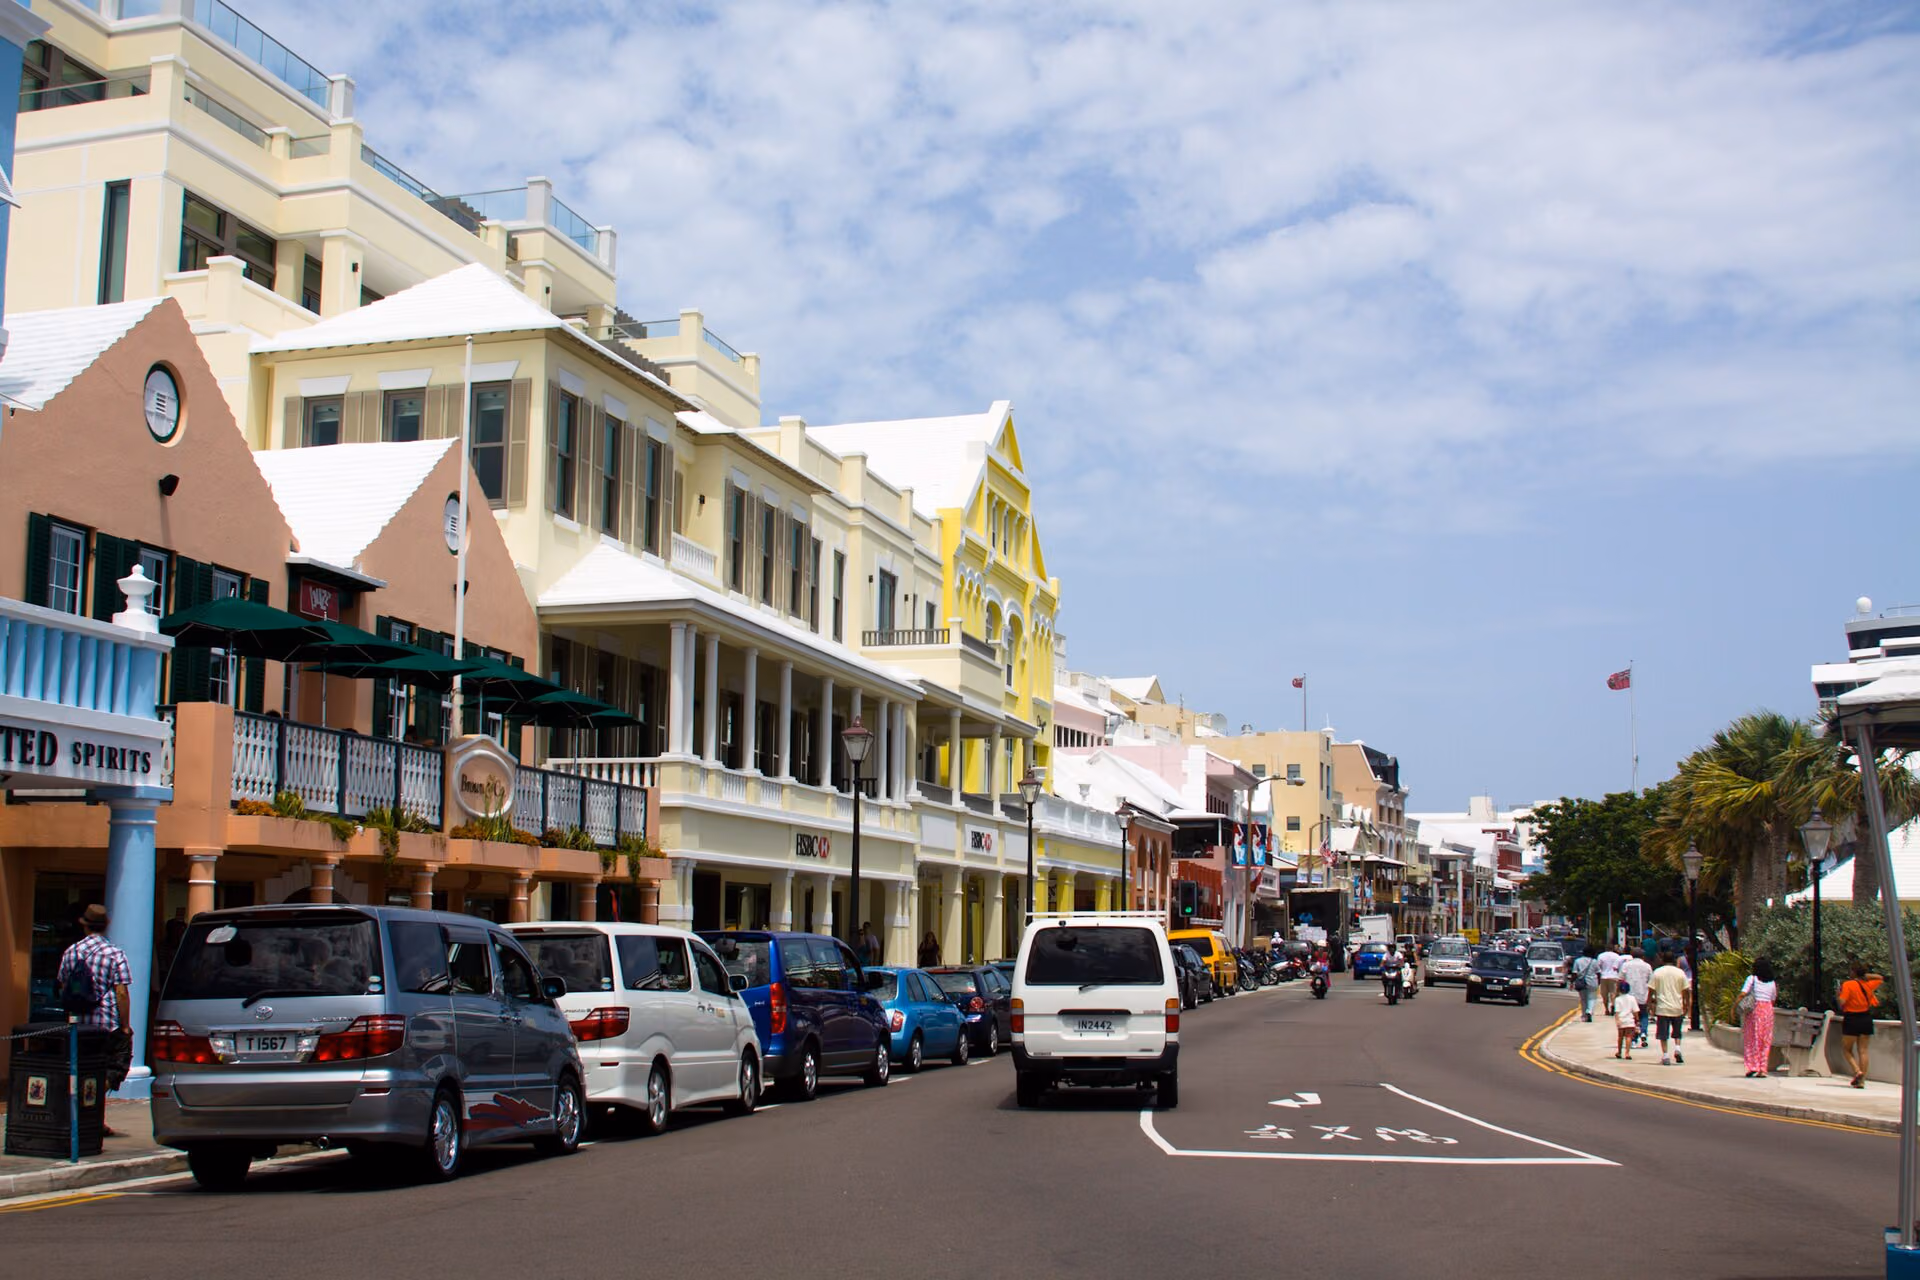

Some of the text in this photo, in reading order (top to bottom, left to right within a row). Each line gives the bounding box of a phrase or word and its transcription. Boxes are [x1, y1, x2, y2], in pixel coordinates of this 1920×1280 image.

[73, 741, 152, 774] SPIRITS
[461, 773, 484, 794] Brown
[796, 833, 818, 857] HSBC
[246, 1036, 287, 1051] T 1567
